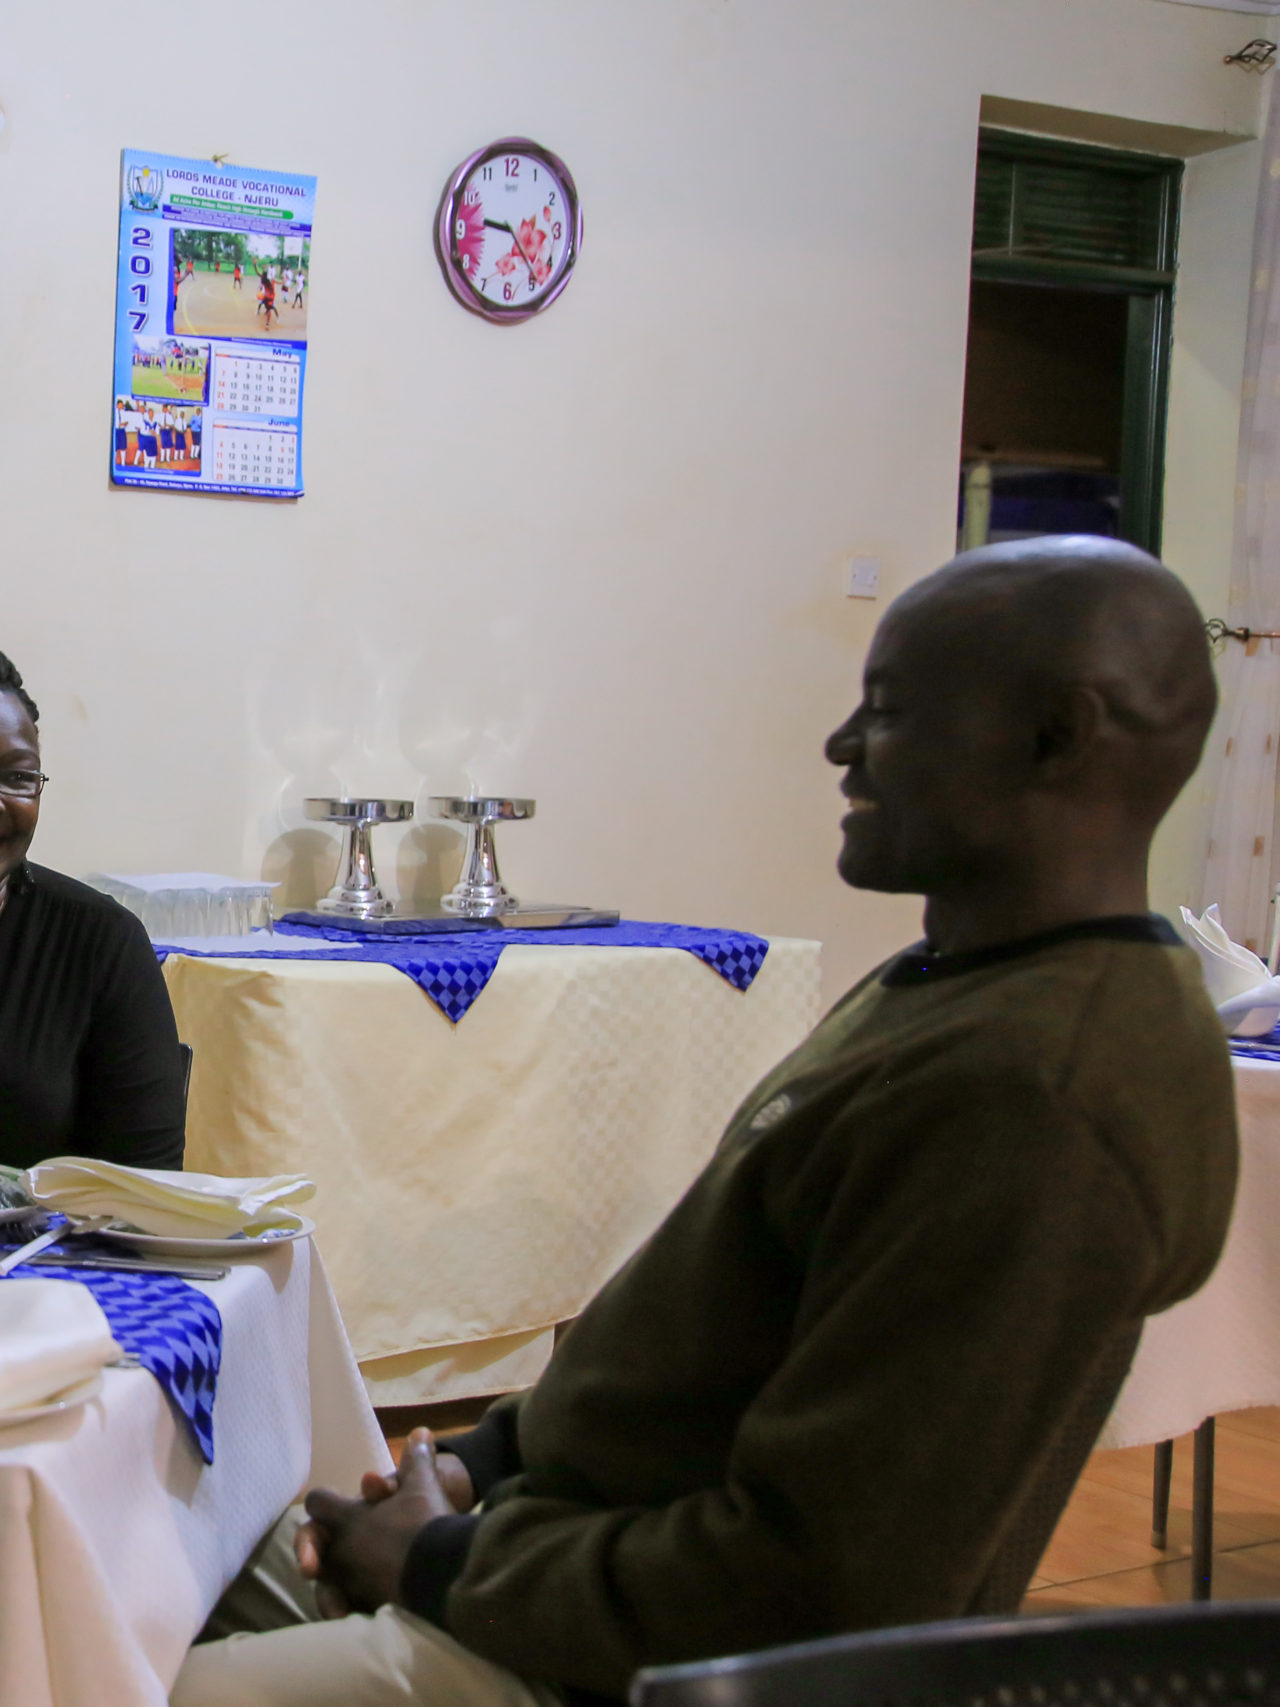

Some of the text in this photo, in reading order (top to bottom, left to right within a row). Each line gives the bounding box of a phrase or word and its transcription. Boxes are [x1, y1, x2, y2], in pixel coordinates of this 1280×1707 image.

[483, 167, 492, 181] 11
[504, 158, 520, 177] 12
[533, 168, 538, 182] 1
[166, 169, 306, 197] LORDS MEADE VOCATIONAL
[191, 186, 234, 200] COLLEGE
[244, 194, 279, 207] NJERU
[549, 192, 555, 206] 2
[456, 220, 466, 239] 9
[553, 222, 561, 240] 3
[481, 278, 487, 291] 7
[503, 282, 512, 300] 6
[529, 278, 535, 291] 5
